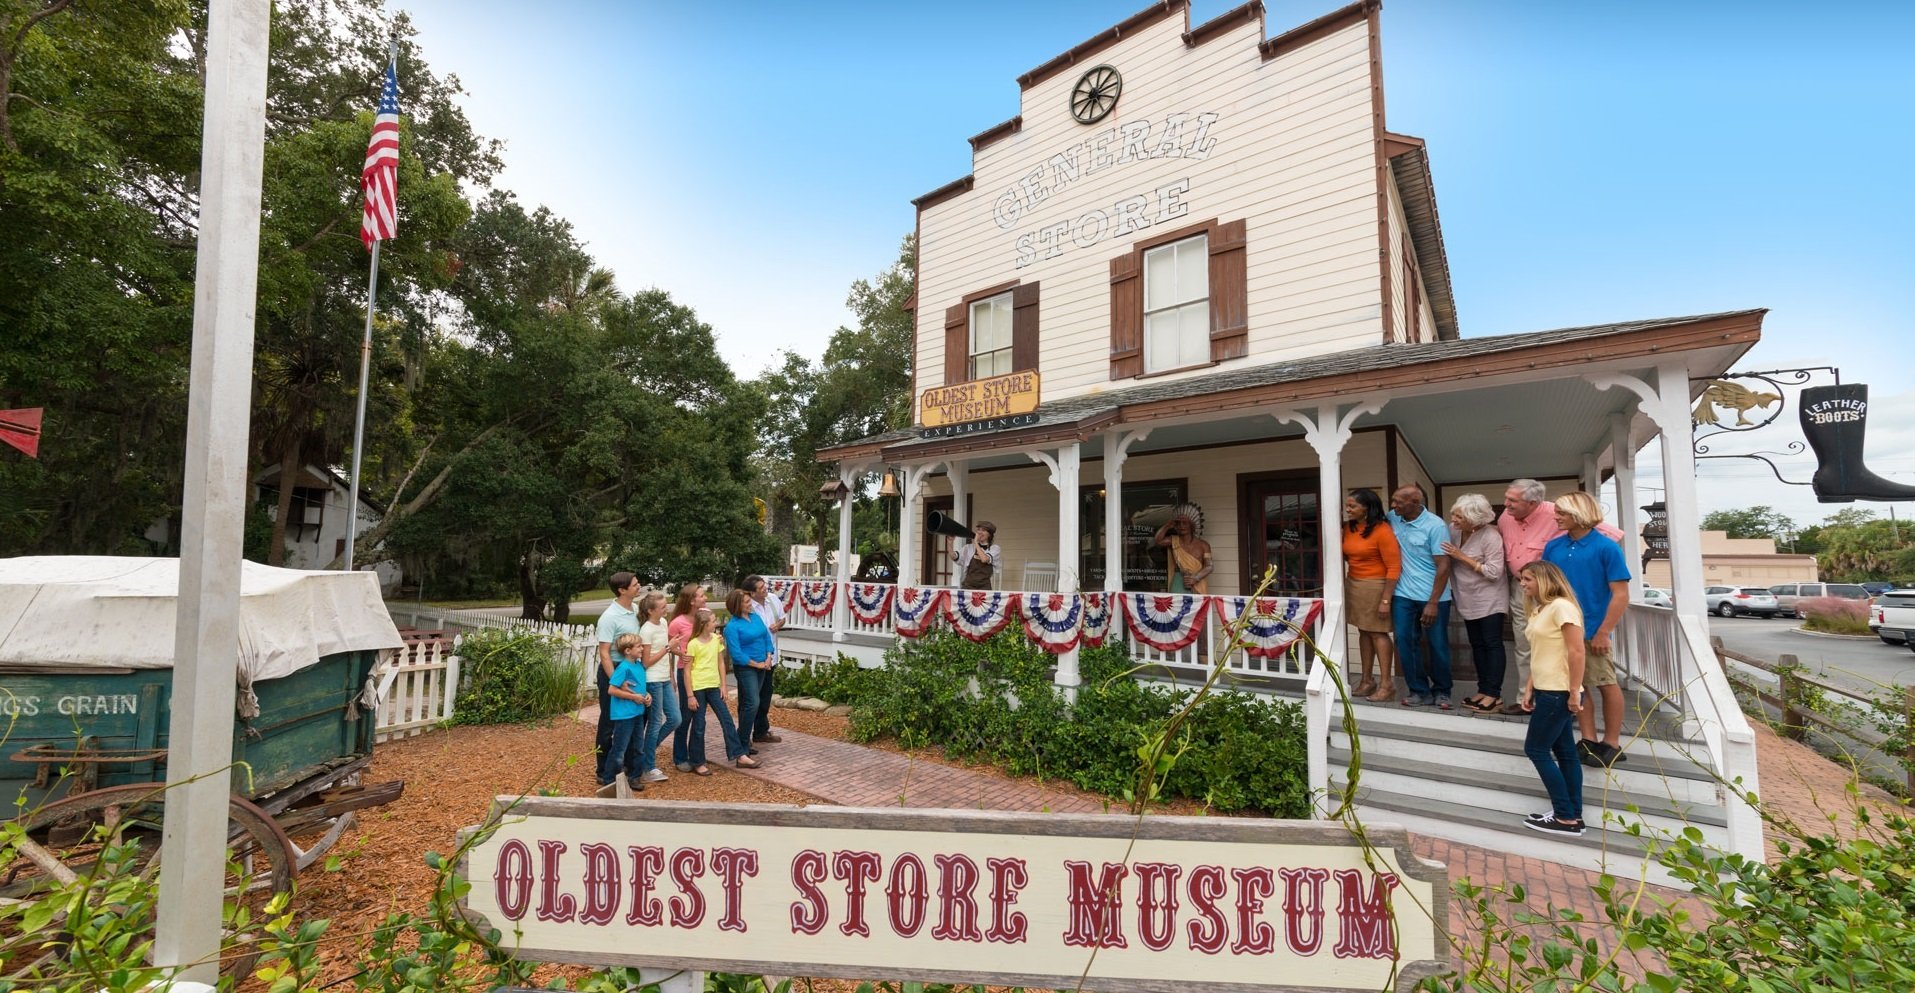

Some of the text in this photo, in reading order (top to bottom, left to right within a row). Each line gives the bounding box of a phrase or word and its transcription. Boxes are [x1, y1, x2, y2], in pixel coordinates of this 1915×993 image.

[993, 112, 1219, 230] GENERAL
[1015, 177, 1190, 270] STORE
[925, 374, 1033, 409] OLDEST STORE
[940, 396, 1011, 424] MUSEUM
[1804, 399, 1867, 416] LEATHER
[1815, 410, 1860, 424] BOOTS
[924, 415, 1033, 438] EXPERIENCE
[1652, 541, 1669, 549] HER
[0, 694, 137, 717] GS GRAIN
[494, 838, 1401, 961] OLDEST STORE MUSEUM
